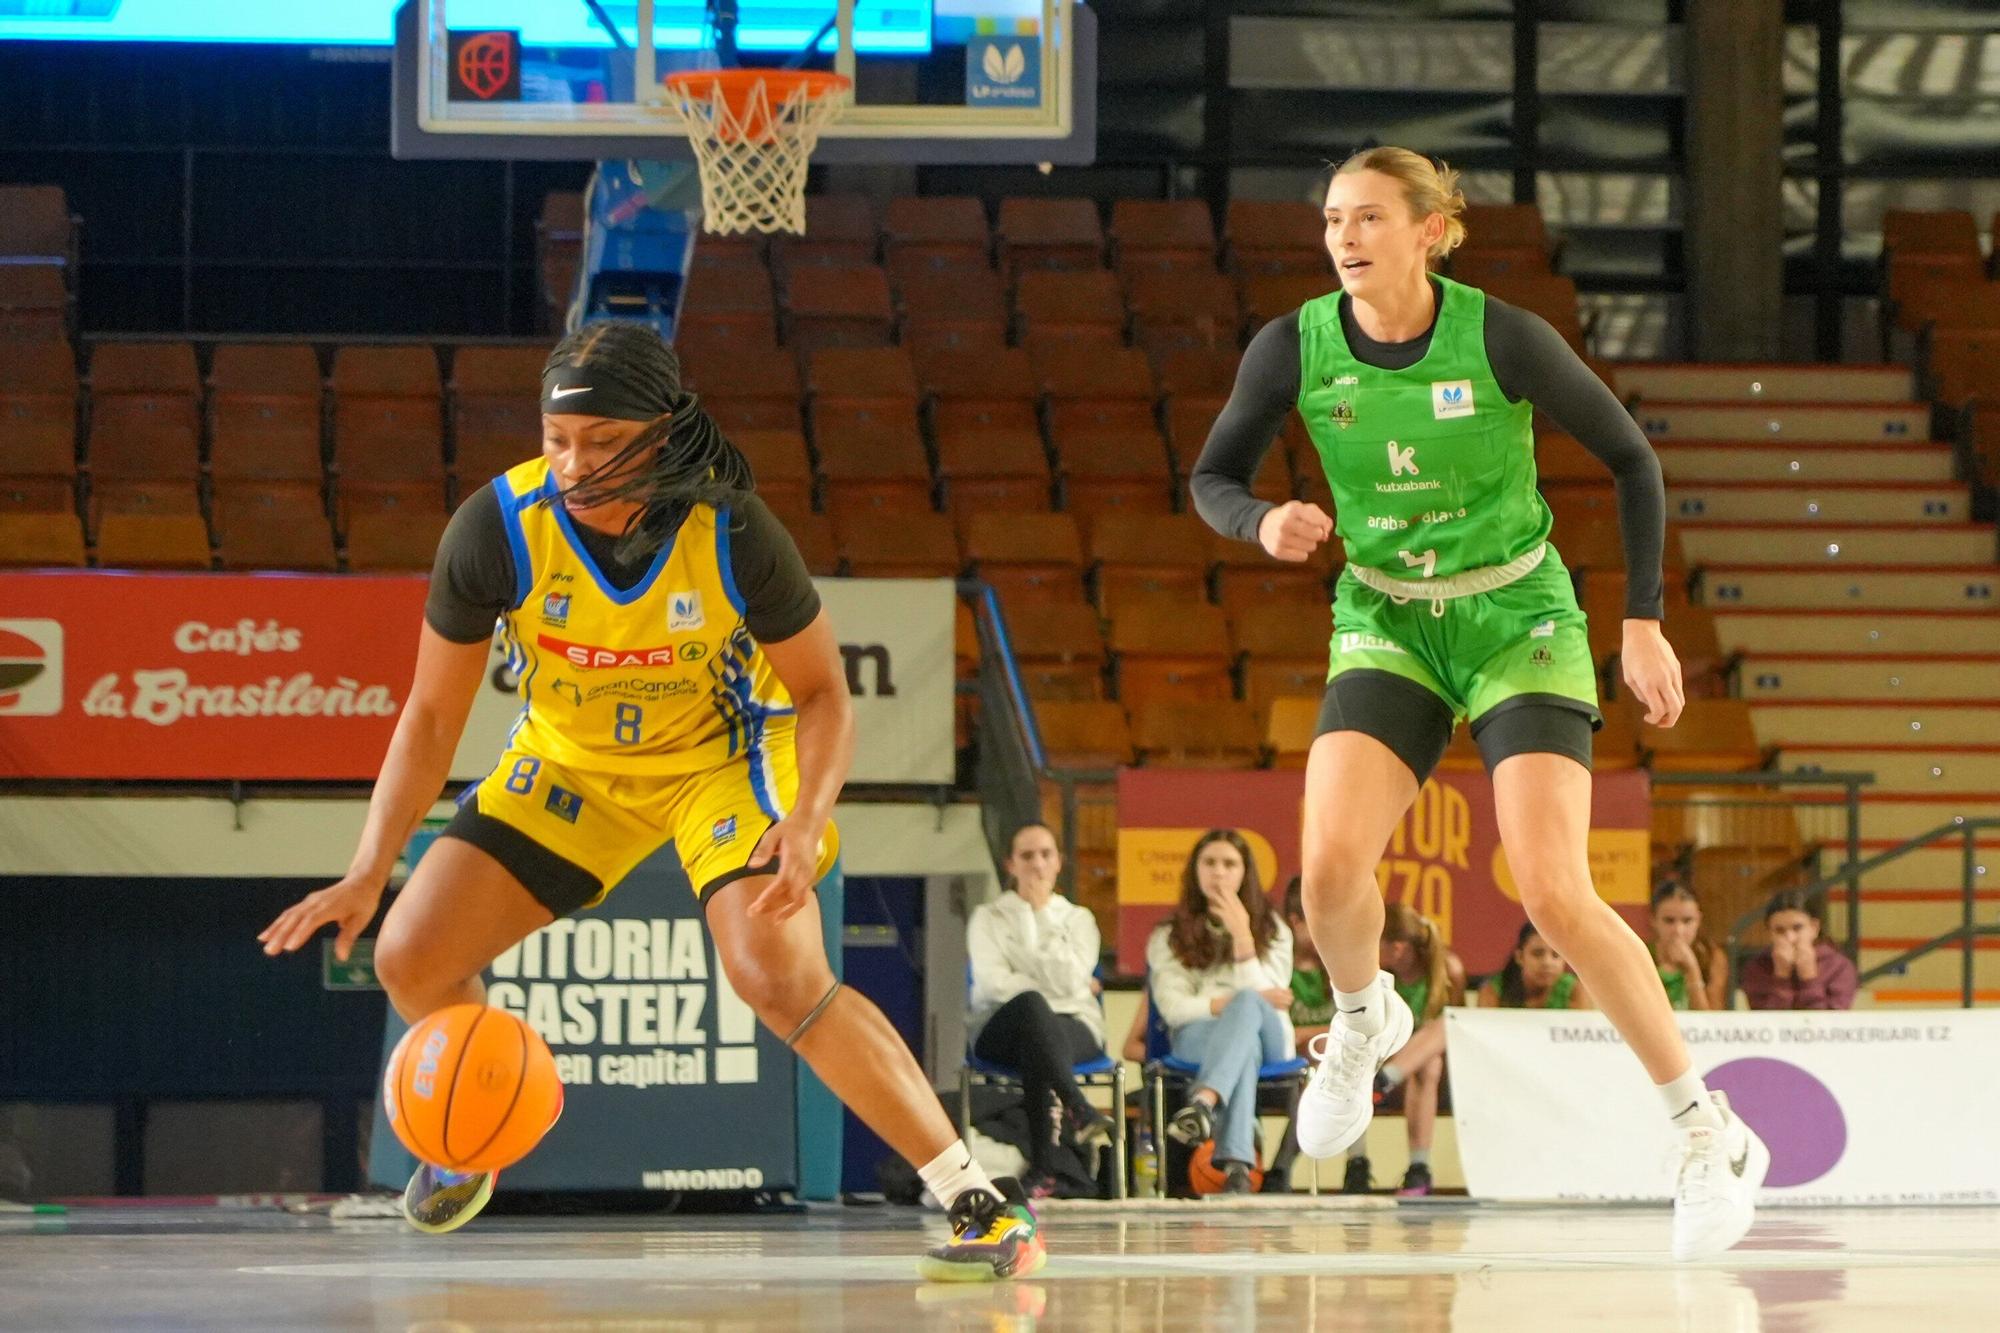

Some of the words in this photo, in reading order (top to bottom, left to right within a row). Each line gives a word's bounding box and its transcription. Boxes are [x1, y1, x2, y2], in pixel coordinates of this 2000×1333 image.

[1375, 479, 1441, 492] kutxabank
[1367, 515, 1409, 530] araba
[173, 618, 303, 655] Cafés
[566, 646, 671, 667] SPAR
[82, 673, 128, 717] la
[132, 668, 396, 726] Brasileña
[614, 702, 643, 745] 8
[505, 757, 541, 795] 8
[491, 918, 709, 979] VITORIA
[488, 982, 707, 1045] GASTEIZ
[599, 1048, 707, 1088] capital
[662, 1167, 764, 1190] MONDO
